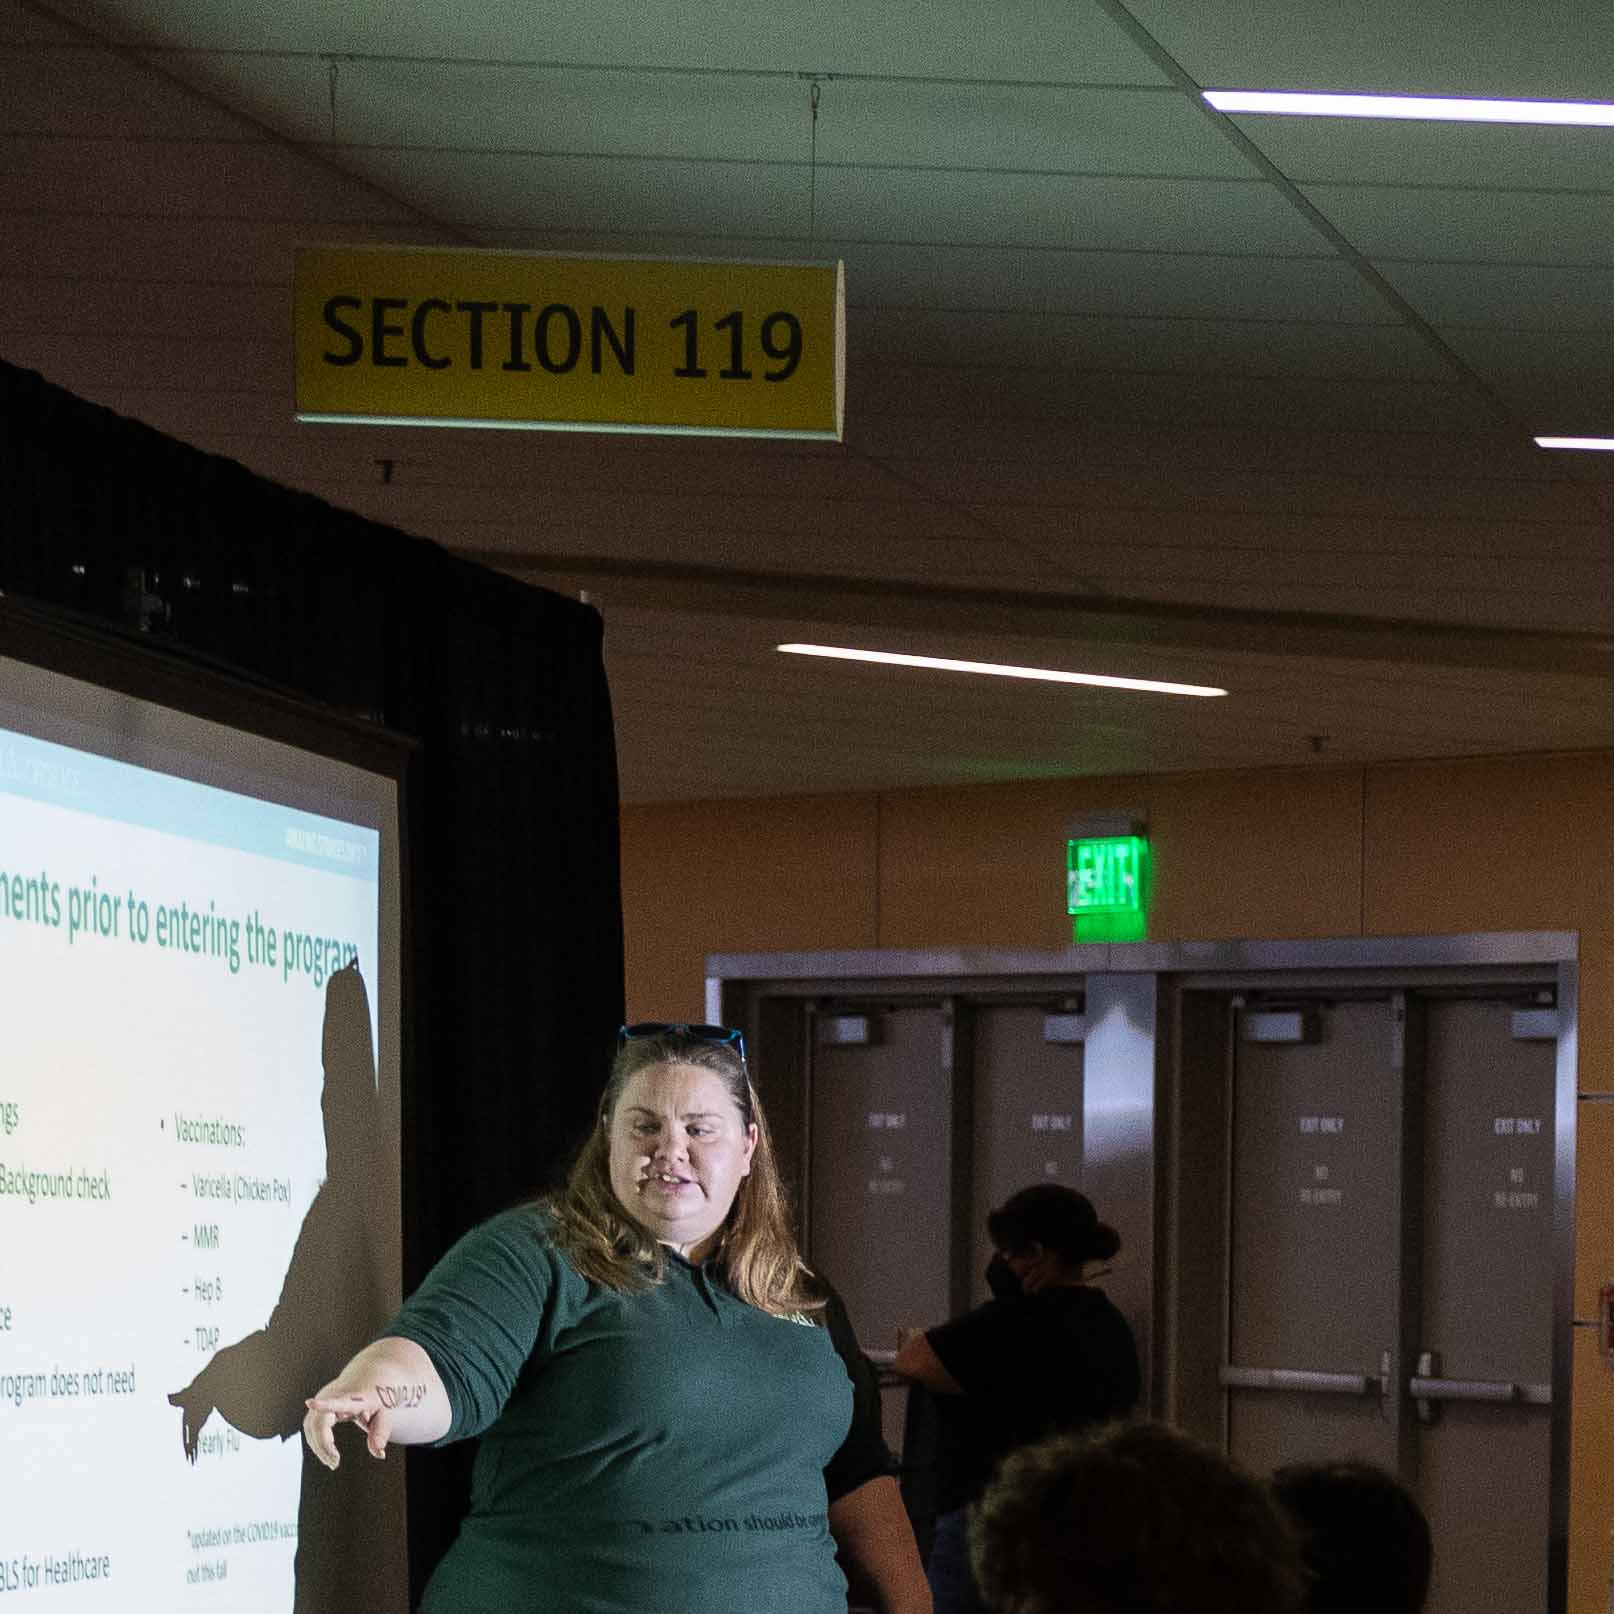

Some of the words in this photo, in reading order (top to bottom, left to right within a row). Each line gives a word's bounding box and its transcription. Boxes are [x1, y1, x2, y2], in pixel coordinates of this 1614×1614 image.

[322, 295, 637, 377] SECTION
[669, 309, 803, 383] 119
[1077, 843, 1131, 906] EXIT
[68, 875, 121, 945] prior
[128, 891, 149, 943] to
[156, 901, 241, 974] entering
[246, 910, 278, 967] the
[175, 1113, 246, 1147] Vaccinations:
[76, 1166, 111, 1200] check
[192, 1173, 232, 1200] Varicella
[234, 1175, 271, 1204] (Chicken
[273, 1179, 291, 1207] Pox)
[193, 1224, 220, 1248] MMR
[194, 1278, 213, 1307] Hep
[195, 1326, 220, 1351] TDAP
[50, 1362, 79, 1396] does
[83, 1367, 103, 1394] not
[107, 1361, 136, 1393] need
[226, 1428, 240, 1453] Flu
[743, 1512, 792, 1531] should
[22, 1554, 40, 1588] for
[45, 1547, 111, 1584] Healthcare
